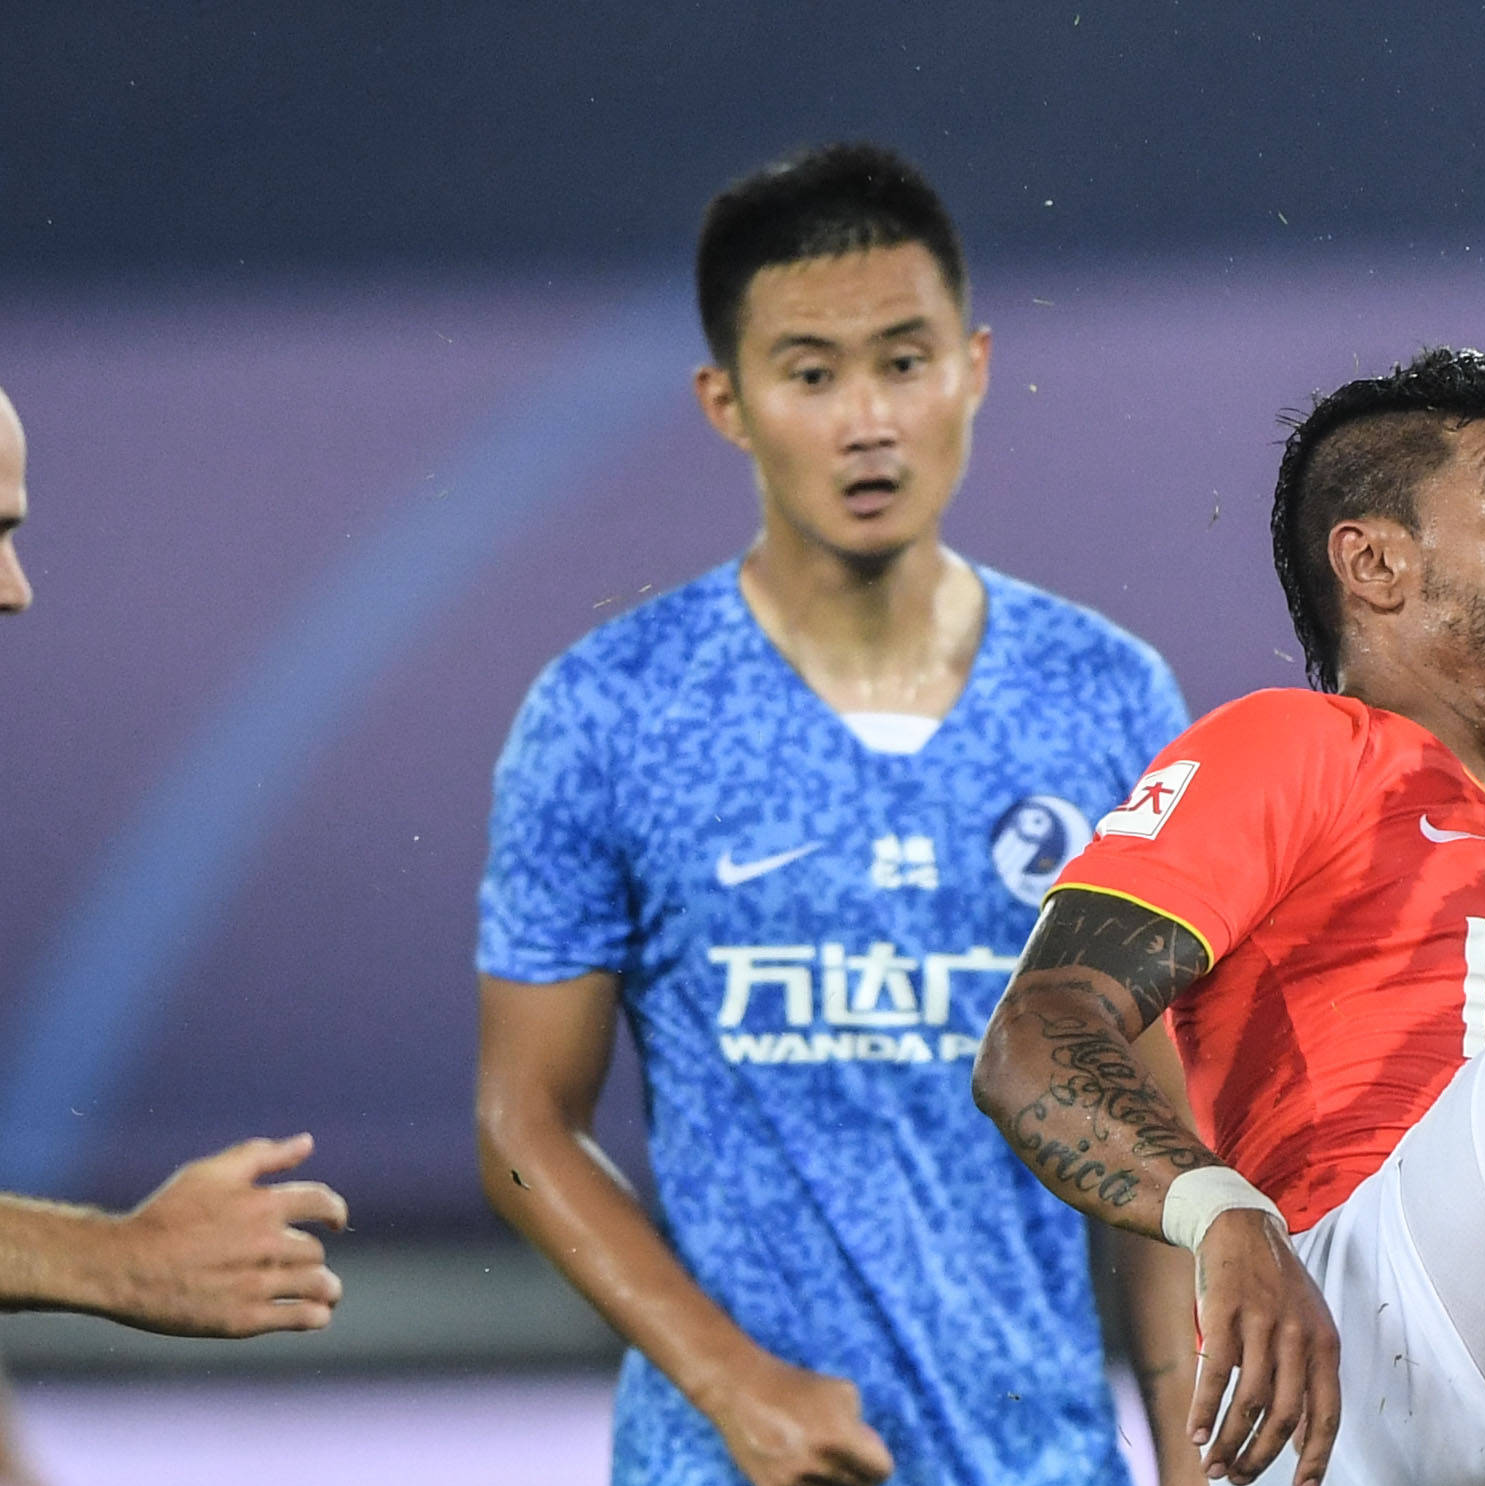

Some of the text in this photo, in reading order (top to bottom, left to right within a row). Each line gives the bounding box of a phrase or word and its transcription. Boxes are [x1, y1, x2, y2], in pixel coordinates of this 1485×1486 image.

[707, 941, 1022, 1028] 万达广
[719, 1031, 933, 1064] WANDA
